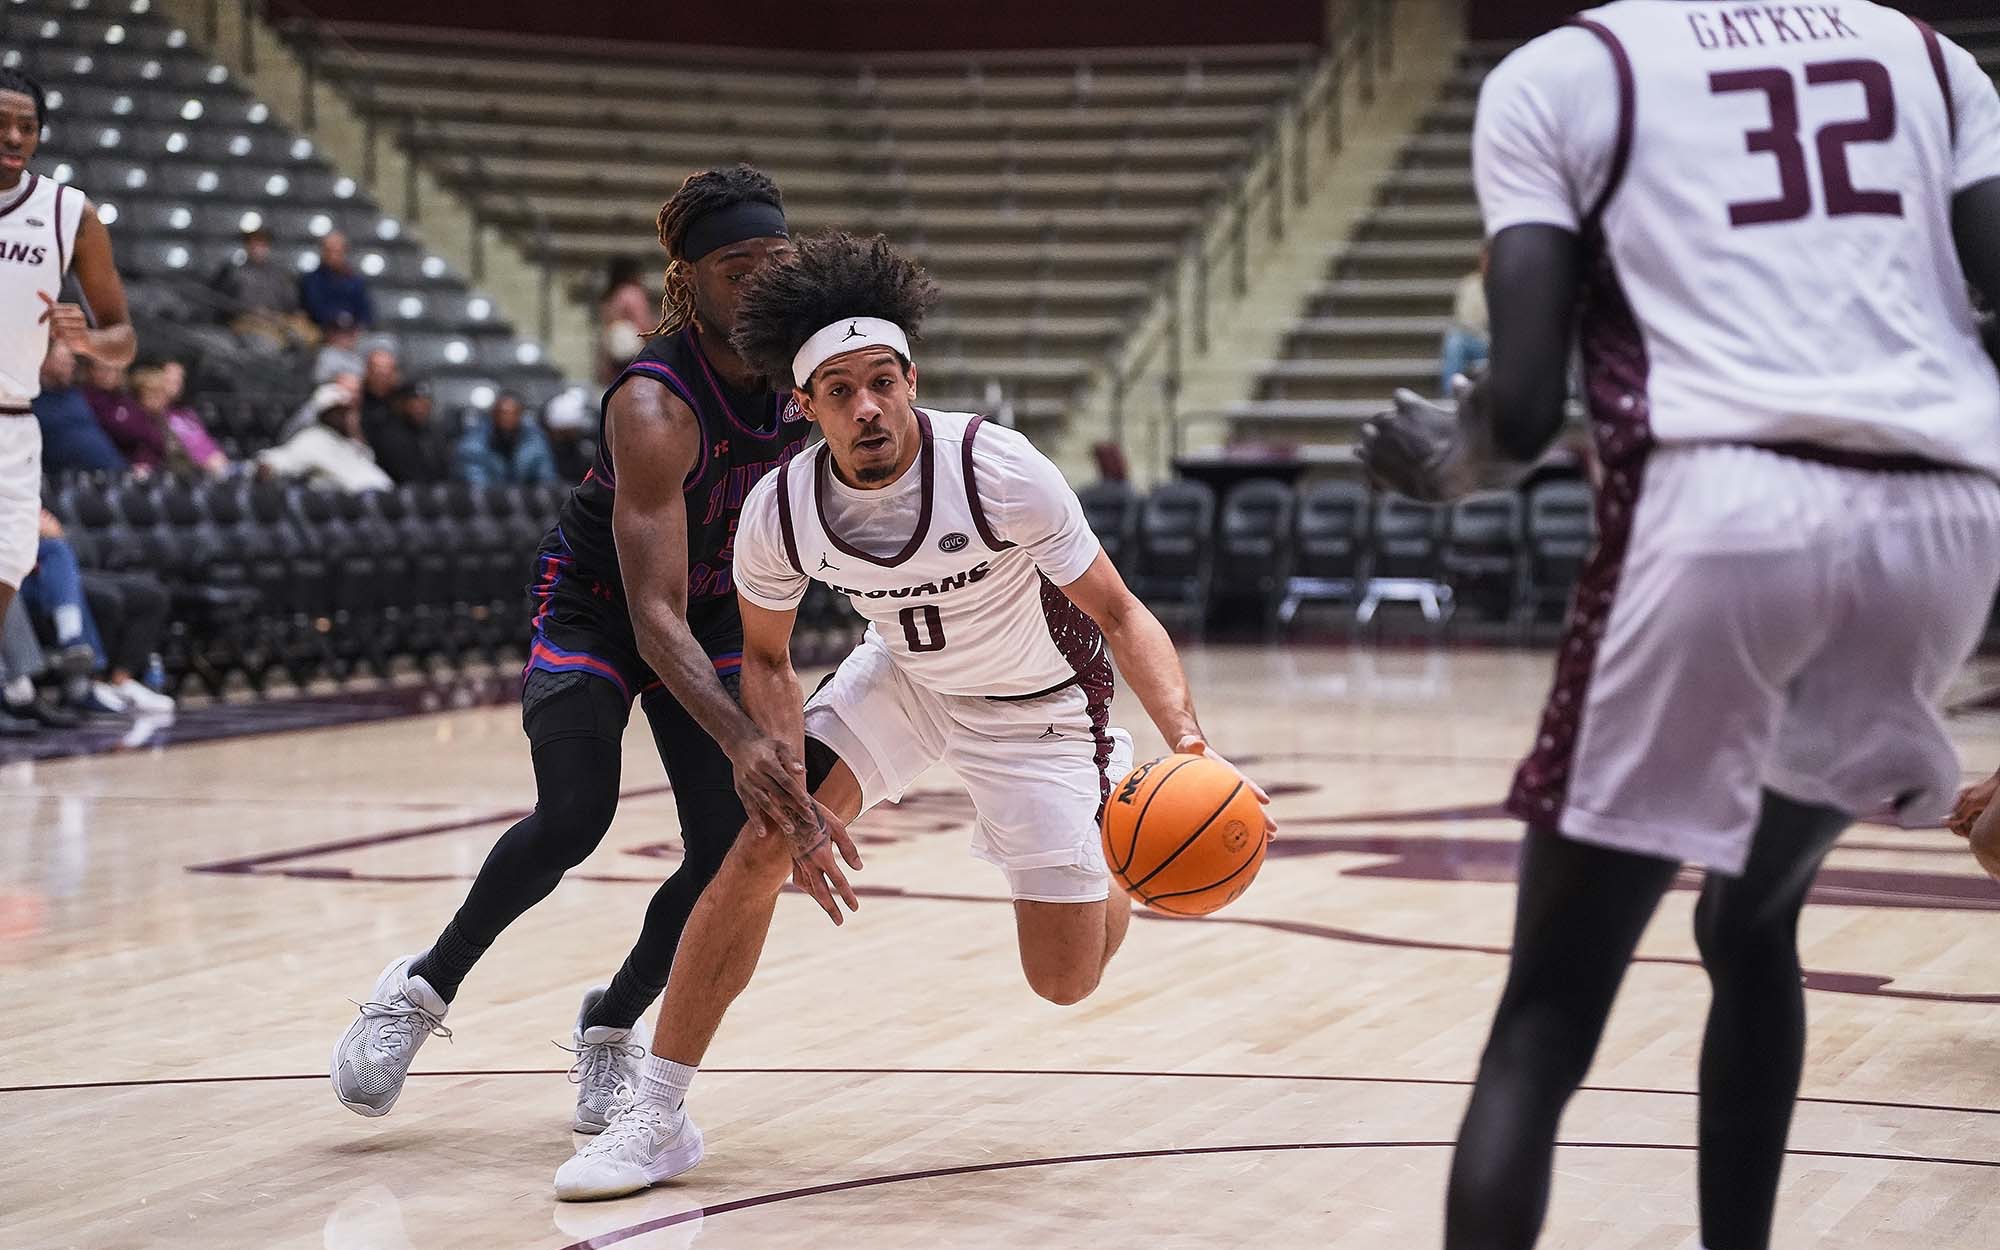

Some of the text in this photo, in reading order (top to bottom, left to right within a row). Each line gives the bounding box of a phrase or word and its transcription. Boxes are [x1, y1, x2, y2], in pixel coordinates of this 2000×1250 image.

[1687, 6, 1859, 50] GATKEK
[1708, 58, 1904, 228] 32
[944, 536, 962, 549] OVC
[898, 604, 947, 653] 0
